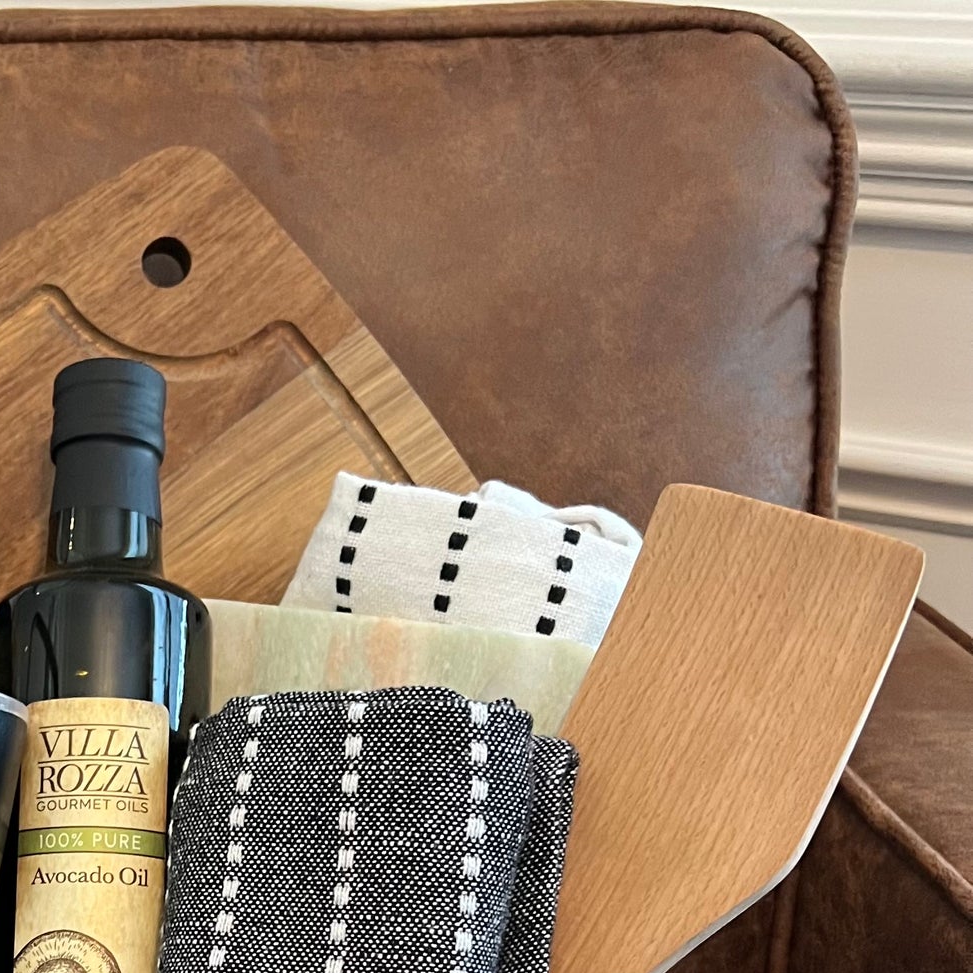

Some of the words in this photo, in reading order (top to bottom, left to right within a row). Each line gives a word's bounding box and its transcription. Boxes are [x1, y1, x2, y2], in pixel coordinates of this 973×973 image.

[39, 728, 148, 760] VILLA
[37, 764, 148, 795] ROZZA
[36, 798, 111, 812] GOURMET
[116, 799, 148, 813] OILS
[39, 833, 83, 849] 100%
[92, 833, 141, 850] PURE
[31, 866, 114, 885] Avocado
[119, 867, 148, 887] Oil
